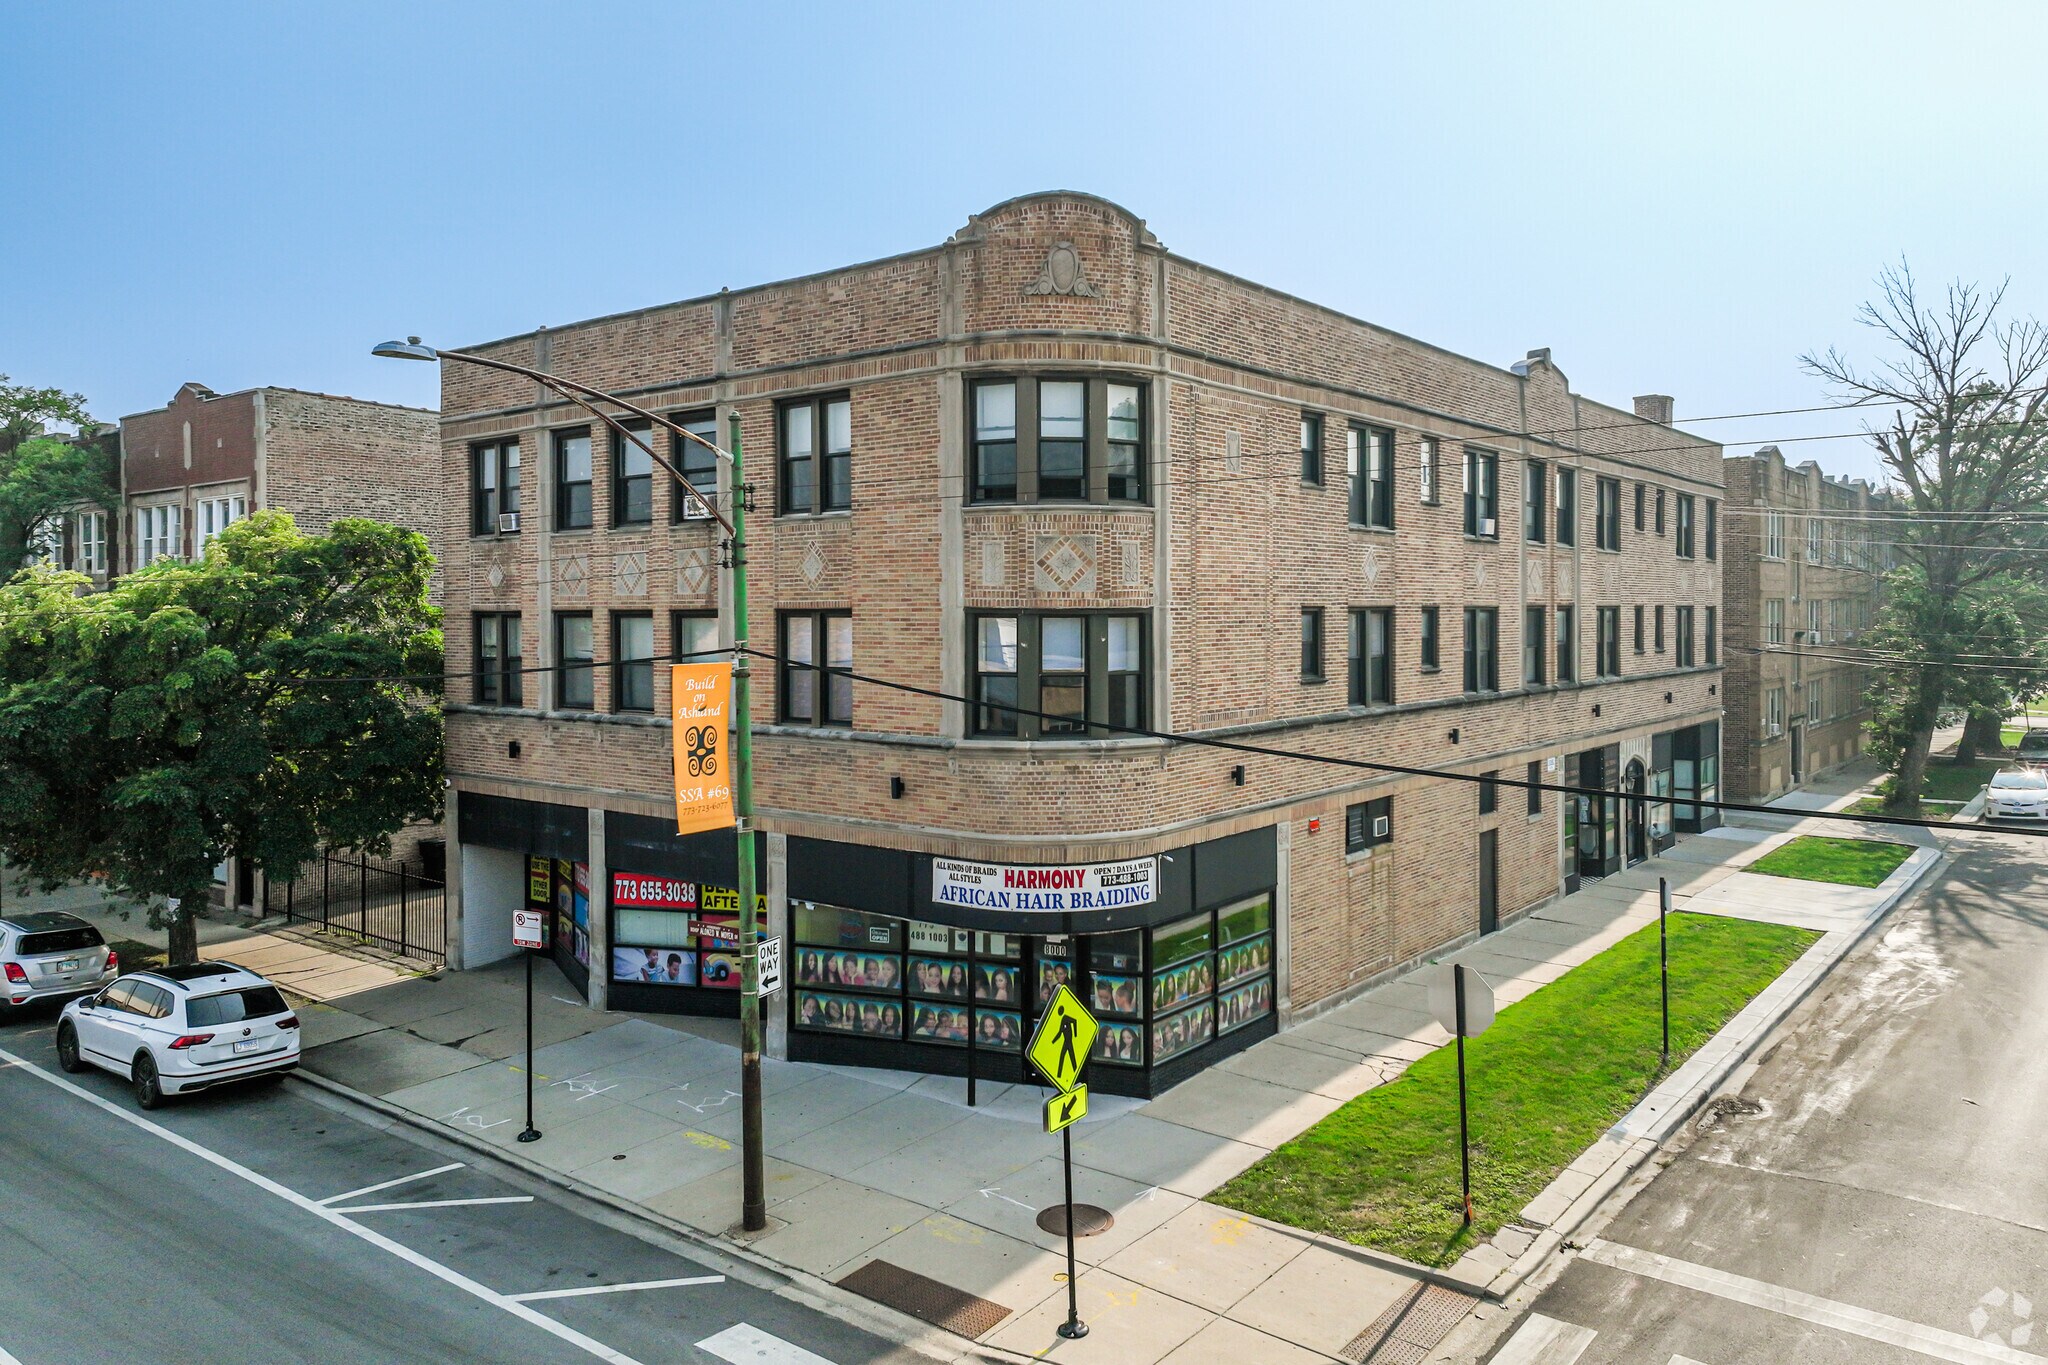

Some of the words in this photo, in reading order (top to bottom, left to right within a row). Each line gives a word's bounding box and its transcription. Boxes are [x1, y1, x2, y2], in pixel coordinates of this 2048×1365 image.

[685, 673, 719, 691] Build
[693, 692, 706, 703] on
[678, 701, 724, 720] Ashland
[679, 786, 704, 804] SSA
[707, 784, 730, 800] #69
[936, 861, 947, 871] ALL
[947, 862, 965, 873] KINDS
[965, 865, 973, 874] OF
[973, 866, 998, 877] BRAIDS
[1093, 867, 1112, 876] OPEN
[1112, 866, 1116, 874] 7
[1116, 864, 1133, 873] DAYS
[1133, 863, 1138, 872] A
[1138, 861, 1153, 870] WEEK
[948, 872, 960, 882] ALL
[960, 874, 982, 885] STYLES
[1004, 869, 1086, 890] HARMONY
[1102, 871, 1148, 886] 773-488-1003
[615, 879, 637, 900] 773
[639, 880, 696, 903] 655-3038
[940, 884, 1011, 908] AFRICAN
[1015, 892, 1065, 910] HAIR
[1070, 884, 1150, 909] BRAIDING
[704, 895, 739, 909] AFTE
[910, 931, 926, 940] 488
[929, 933, 948, 943] 1003
[760, 942, 778, 960] ONE
[1045, 944, 1067, 956] 8000
[759, 956, 779, 975] WAY
